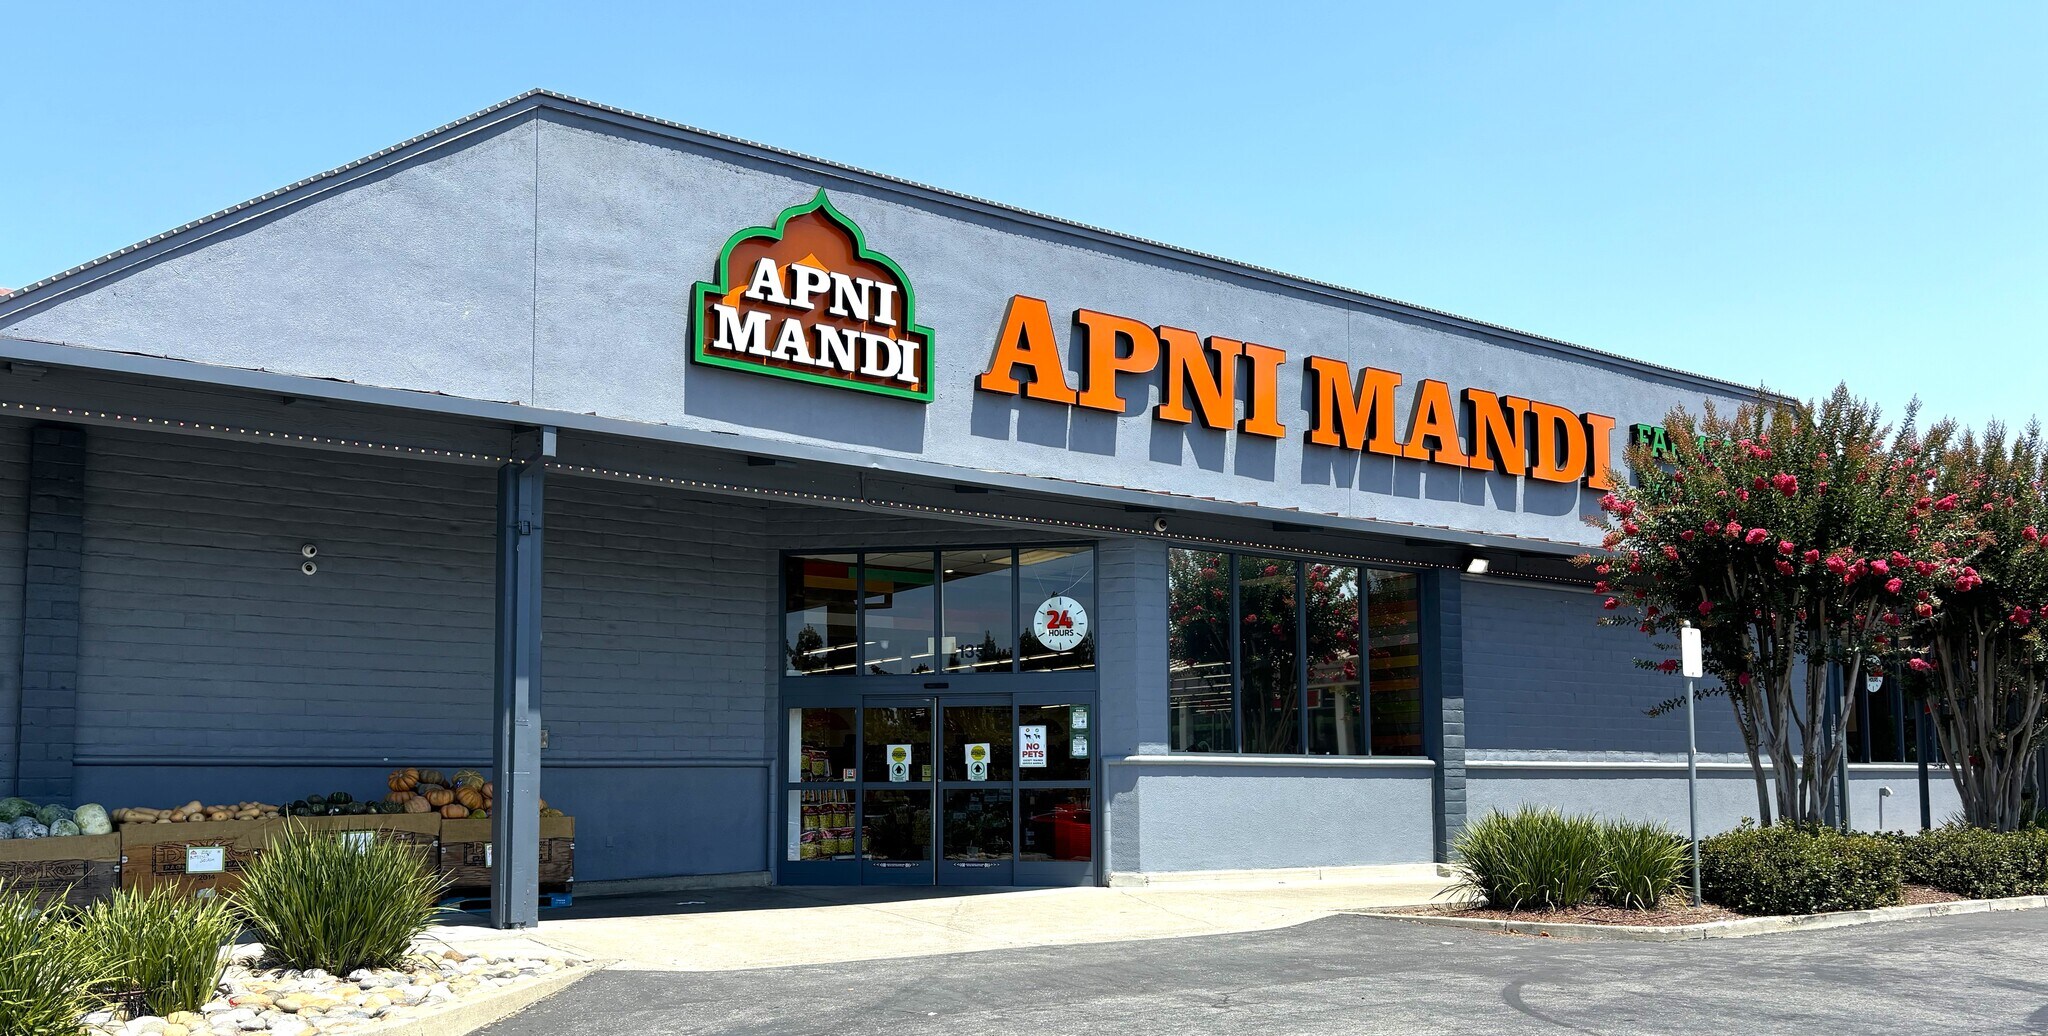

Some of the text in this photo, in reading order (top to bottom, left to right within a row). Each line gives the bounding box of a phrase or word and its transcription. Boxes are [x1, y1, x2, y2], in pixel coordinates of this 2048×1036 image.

[745, 257, 897, 326] APNI
[713, 303, 919, 383] MANDI
[977, 294, 1616, 491] APNI MANDI
[1046, 609, 1073, 629] 24
[1022, 750, 1044, 758] PETS
